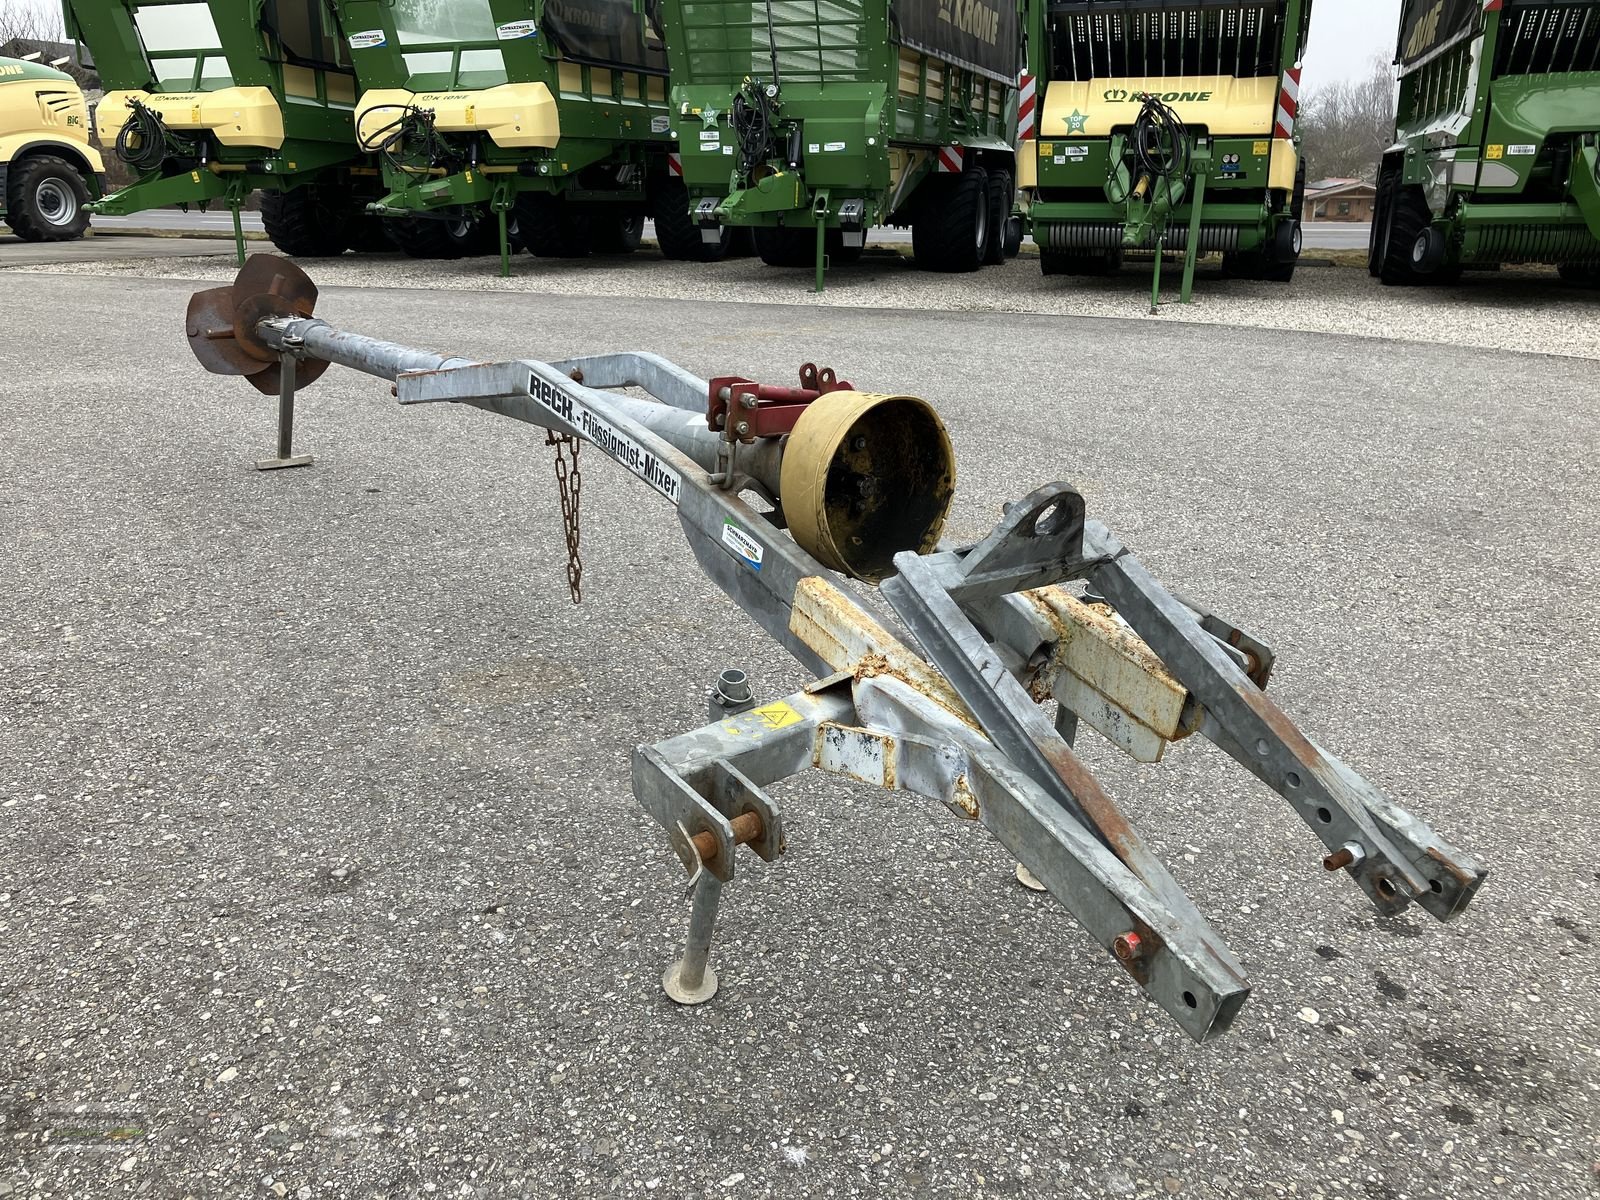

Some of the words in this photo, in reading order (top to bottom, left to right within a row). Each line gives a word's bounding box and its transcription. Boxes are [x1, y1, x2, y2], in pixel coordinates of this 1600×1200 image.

[564, 6, 608, 30] KRONE
[952, 0, 998, 46] KRONE
[704, 110, 715, 118] TOP
[726, 524, 758, 553] SCHWARZMAYR
